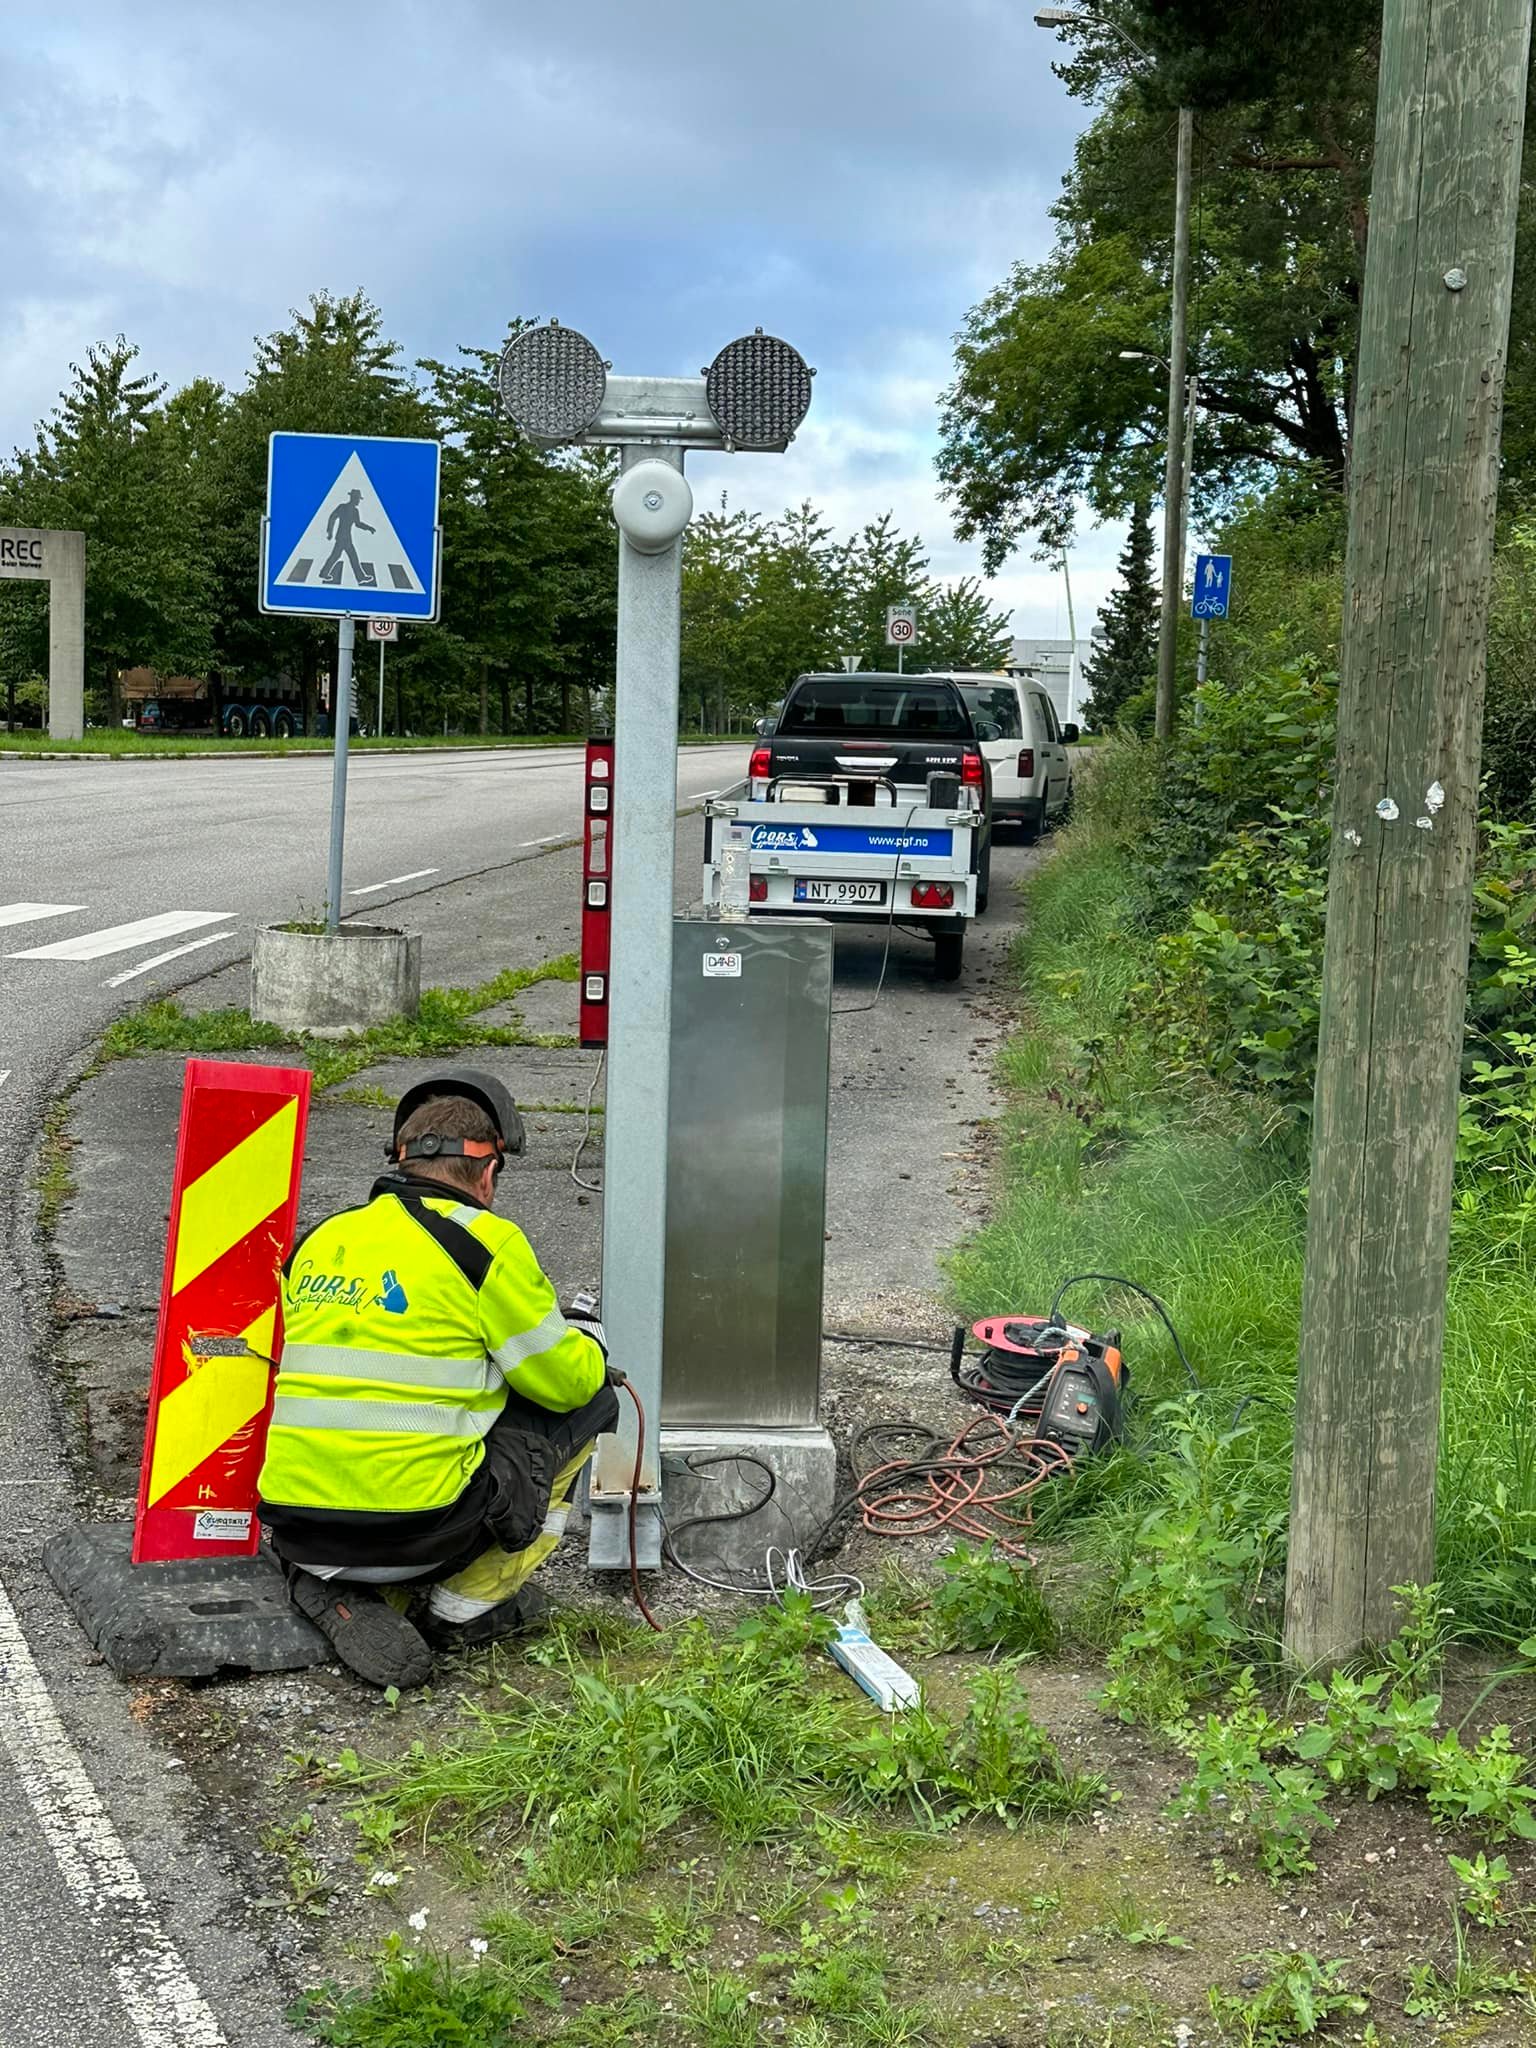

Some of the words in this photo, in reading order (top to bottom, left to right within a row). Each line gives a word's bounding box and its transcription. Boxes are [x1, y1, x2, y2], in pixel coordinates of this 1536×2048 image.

[1, 538, 42, 560] REC
[375, 620, 390, 631] 30
[895, 624, 909, 636] 30
[868, 836, 929, 848] www.pgf.no
[811, 883, 832, 898] NT
[838, 884, 877, 899] 9907
[296, 1274, 364, 1297] PORS
